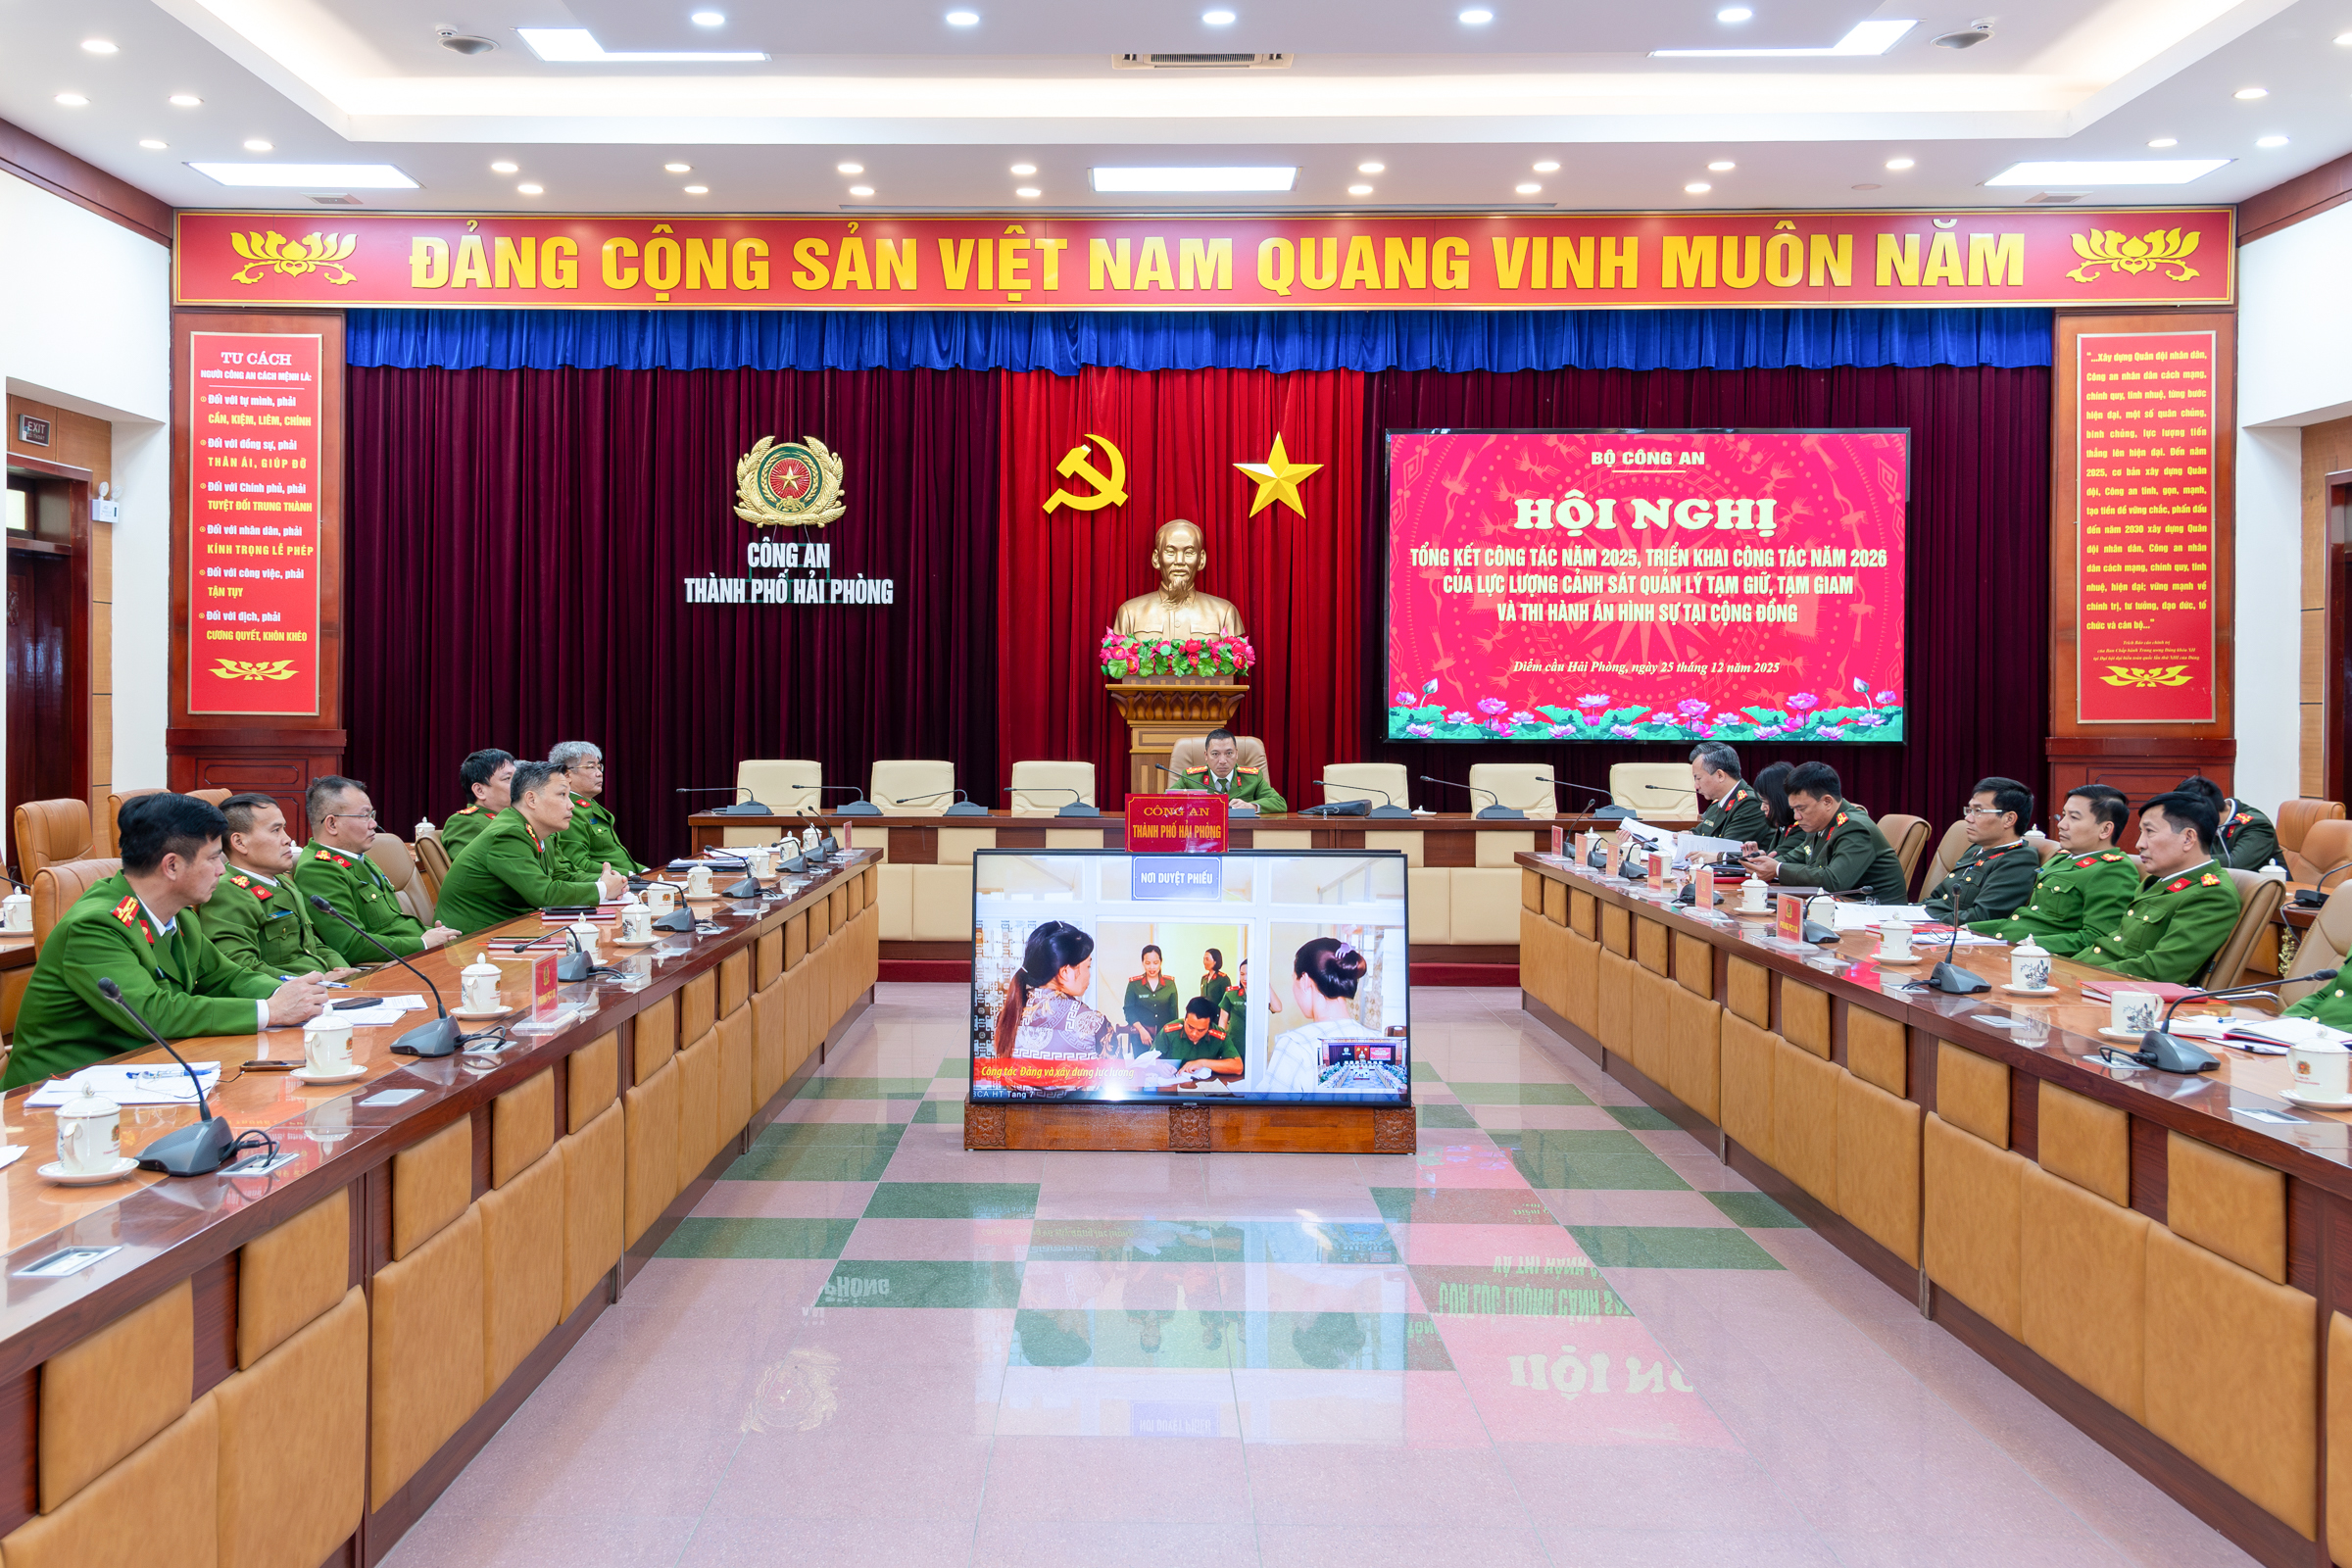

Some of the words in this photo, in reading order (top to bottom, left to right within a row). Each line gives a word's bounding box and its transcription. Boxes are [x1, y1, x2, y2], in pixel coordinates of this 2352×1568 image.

[409, 220, 578, 289] ĐẢNG
[601, 224, 770, 302] CỘNG
[792, 221, 917, 292] SẢN
[937, 224, 1067, 302] VIỆT
[1089, 237, 1233, 291] NAM
[1257, 236, 1470, 296] QUANG
[1492, 236, 1639, 290] VINH
[1661, 220, 1853, 289] MUÔN
[1876, 219, 2025, 286] NĂM
[246, 350, 292, 366] CÁCH
[223, 369, 244, 379] CÔNG
[257, 370, 276, 380] CÁCH
[2086, 372, 2106, 381] Công
[2121, 370, 2140, 380] nhân
[2160, 369, 2180, 379] cách
[224, 394, 238, 405] với
[276, 395, 296, 407] phải
[230, 413, 256, 426] KIỆM,
[258, 414, 282, 426] LIÊM,
[283, 415, 311, 426] CHÍNH
[27, 420, 45, 434] EXIT
[208, 455, 237, 466] THÂN
[240, 456, 257, 468] ÁI,
[261, 457, 288, 468] GIÚP
[1591, 449, 1615, 467] BỘ
[1622, 448, 1672, 465] CÔNG
[1678, 451, 1704, 465] AN
[207, 498, 233, 512] TUYỆT
[235, 498, 250, 511] ĐỐI
[252, 501, 281, 512] TRUNG
[282, 500, 312, 512] THÀNH
[1513, 488, 1616, 536] HỘI
[1630, 498, 1777, 537] NGHỊ
[2104, 524, 2121, 533] năm
[2125, 524, 2144, 533] 2030
[2147, 524, 2161, 534] xây
[2187, 523, 2207, 533] Quân
[207, 542, 232, 554] KÍNH
[235, 544, 269, 557] TRỌNG
[286, 544, 314, 556] PHÉP
[748, 536, 799, 568] CÔNG
[803, 543, 830, 568] AN
[2103, 544, 2123, 553] nhân
[2148, 543, 2168, 553] Công
[2187, 543, 2207, 552] nhân
[1409, 541, 1449, 566] TỔNG
[1453, 542, 1481, 570] KẾT
[1484, 544, 1525, 566] CÔNG
[1529, 544, 1557, 566] TÁC
[1561, 545, 1596, 570] NĂM
[1600, 548, 1642, 568] 2025,
[1644, 541, 1689, 570] TRIỂN
[1692, 548, 1728, 566] KHAI
[1733, 545, 1774, 567] CÔNG
[1778, 545, 1806, 567] TÁC
[1810, 545, 1845, 566] NĂM
[1850, 549, 1886, 567] 2026
[2086, 564, 2100, 572] dân
[2103, 564, 2122, 572] cách
[684, 572, 745, 603] THÀNH
[752, 568, 789, 603] PHỐ
[793, 569, 825, 603] HẢI
[830, 572, 894, 605] PHÒNG
[1443, 569, 1473, 593] CỦA
[1477, 572, 1504, 597] LỰC
[1509, 572, 1557, 597] LƯỢNG
[1562, 569, 1603, 594] CẢNH
[1607, 570, 1636, 594] SÁT
[1640, 569, 1681, 596] QUẢN
[1685, 571, 1702, 594] LÝ
[1706, 575, 1739, 598] TẠM
[1743, 570, 1773, 596] GIỮ,
[1777, 575, 1809, 598] TẠM
[1813, 575, 1853, 594] GIAM
[208, 585, 224, 598] TẬN
[226, 587, 243, 599] TỤY
[222, 611, 236, 620] với
[262, 611, 280, 622] phải
[1496, 599, 1516, 621] VÀ
[1519, 603, 1543, 621] THI
[1547, 599, 1589, 621] HÀNH
[1592, 599, 1614, 621] ÁN
[1618, 599, 1654, 621] HÌNH
[1658, 602, 1681, 625] SỰ
[1683, 603, 1706, 625] TẠI
[1710, 600, 1751, 626] CỘNG
[1755, 597, 1797, 622] ĐỒNG
[2106, 620, 2116, 629] và
[2118, 620, 2132, 629] cán
[263, 629, 284, 641] KHÔN
[1544, 658, 1564, 671] cầu
[1567, 661, 1589, 672] Hải
[1590, 661, 1629, 675] Phòng,
[1631, 661, 1658, 674] ngày
[1659, 662, 1674, 672] 25
[1676, 661, 1708, 675] tháng
[1710, 662, 1724, 672] 12
[1726, 662, 1750, 672] năm
[1752, 662, 1780, 672] 2025
[1144, 805, 1184, 816] CÔNG
[1189, 808, 1210, 816] AN
[1133, 822, 1158, 838] THÀNH
[1160, 820, 1177, 838] PHỐ
[1179, 820, 1192, 838] HẢI
[1195, 822, 1221, 839] PHÒNG
[1141, 872, 1155, 883] NƠI
[1158, 870, 1185, 886] DUYỆT
[1187, 869, 1213, 884] PHIẾU
[981, 1066, 1002, 1078] Công
[1004, 1066, 1017, 1076] tác
[1019, 1066, 1042, 1078] Đảng
[1045, 1067, 1054, 1076] và
[1054, 1066, 1069, 1079] xây
[1071, 1066, 1094, 1079] dựng
